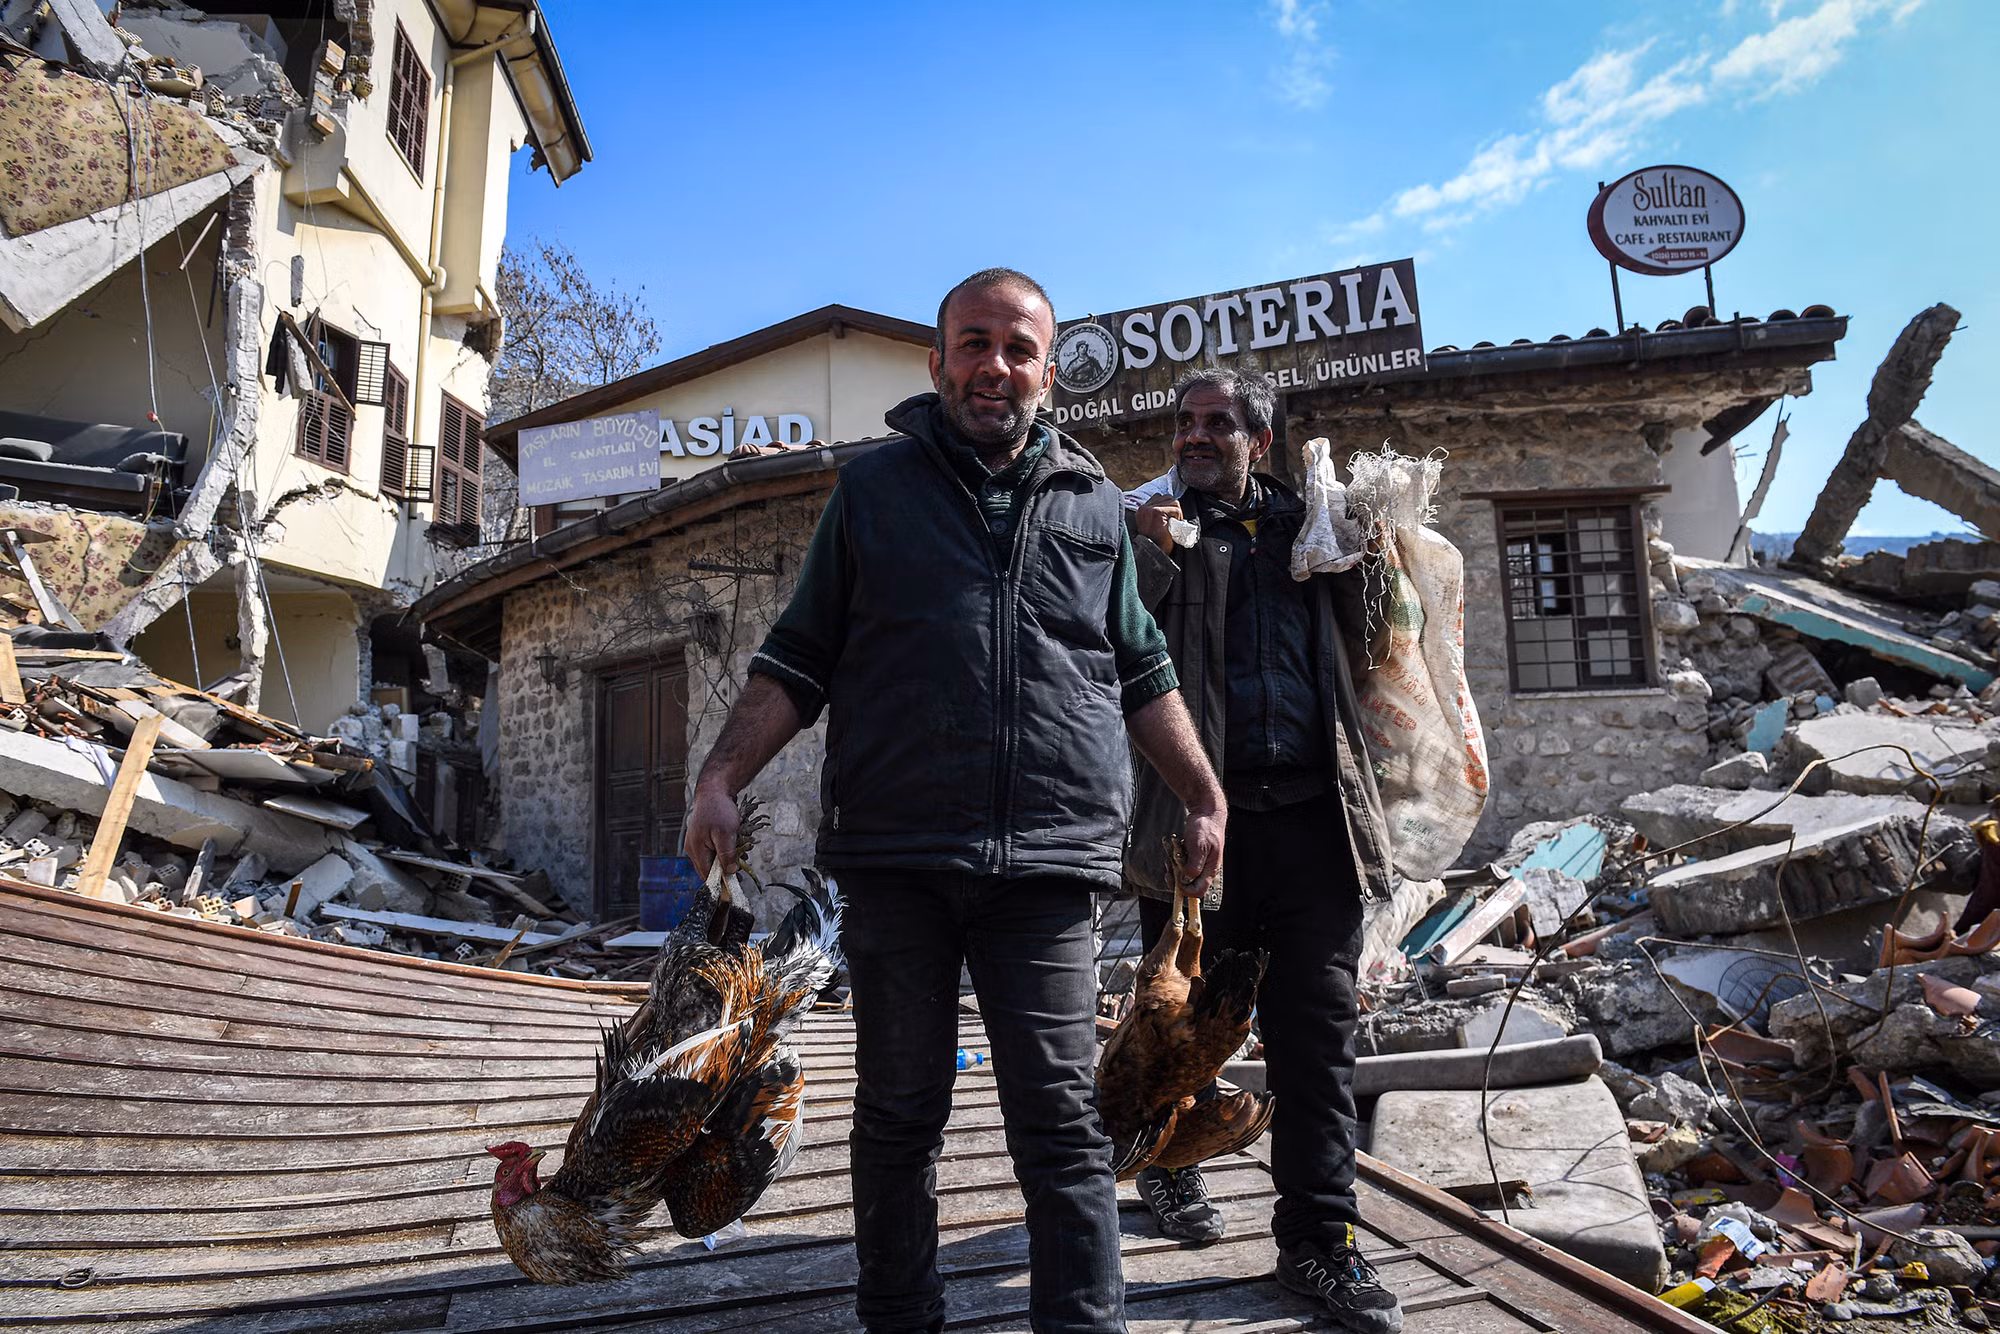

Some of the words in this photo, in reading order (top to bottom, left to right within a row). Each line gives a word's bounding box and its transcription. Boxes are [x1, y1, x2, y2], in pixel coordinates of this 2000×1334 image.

[1633, 172, 1707, 211] Sultan
[1634, 214, 1688, 227] KAHVALTI
[1692, 211, 1710, 225] EVİ
[1615, 233, 1645, 245] CAFE
[1658, 230, 1732, 244] RESTAURANT
[1122, 267, 1416, 370] SOTERIA
[1056, 398, 1123, 424] DOĞAL
[1316, 348, 1421, 381] ÜRÜNLER
[520, 424, 580, 458] TAŞLARIN
[593, 418, 659, 448] BÜYÜSÜ
[570, 442, 635, 460] SANATLARI
[582, 466, 634, 485] TASARIM
[639, 458, 658, 477] EVİ
